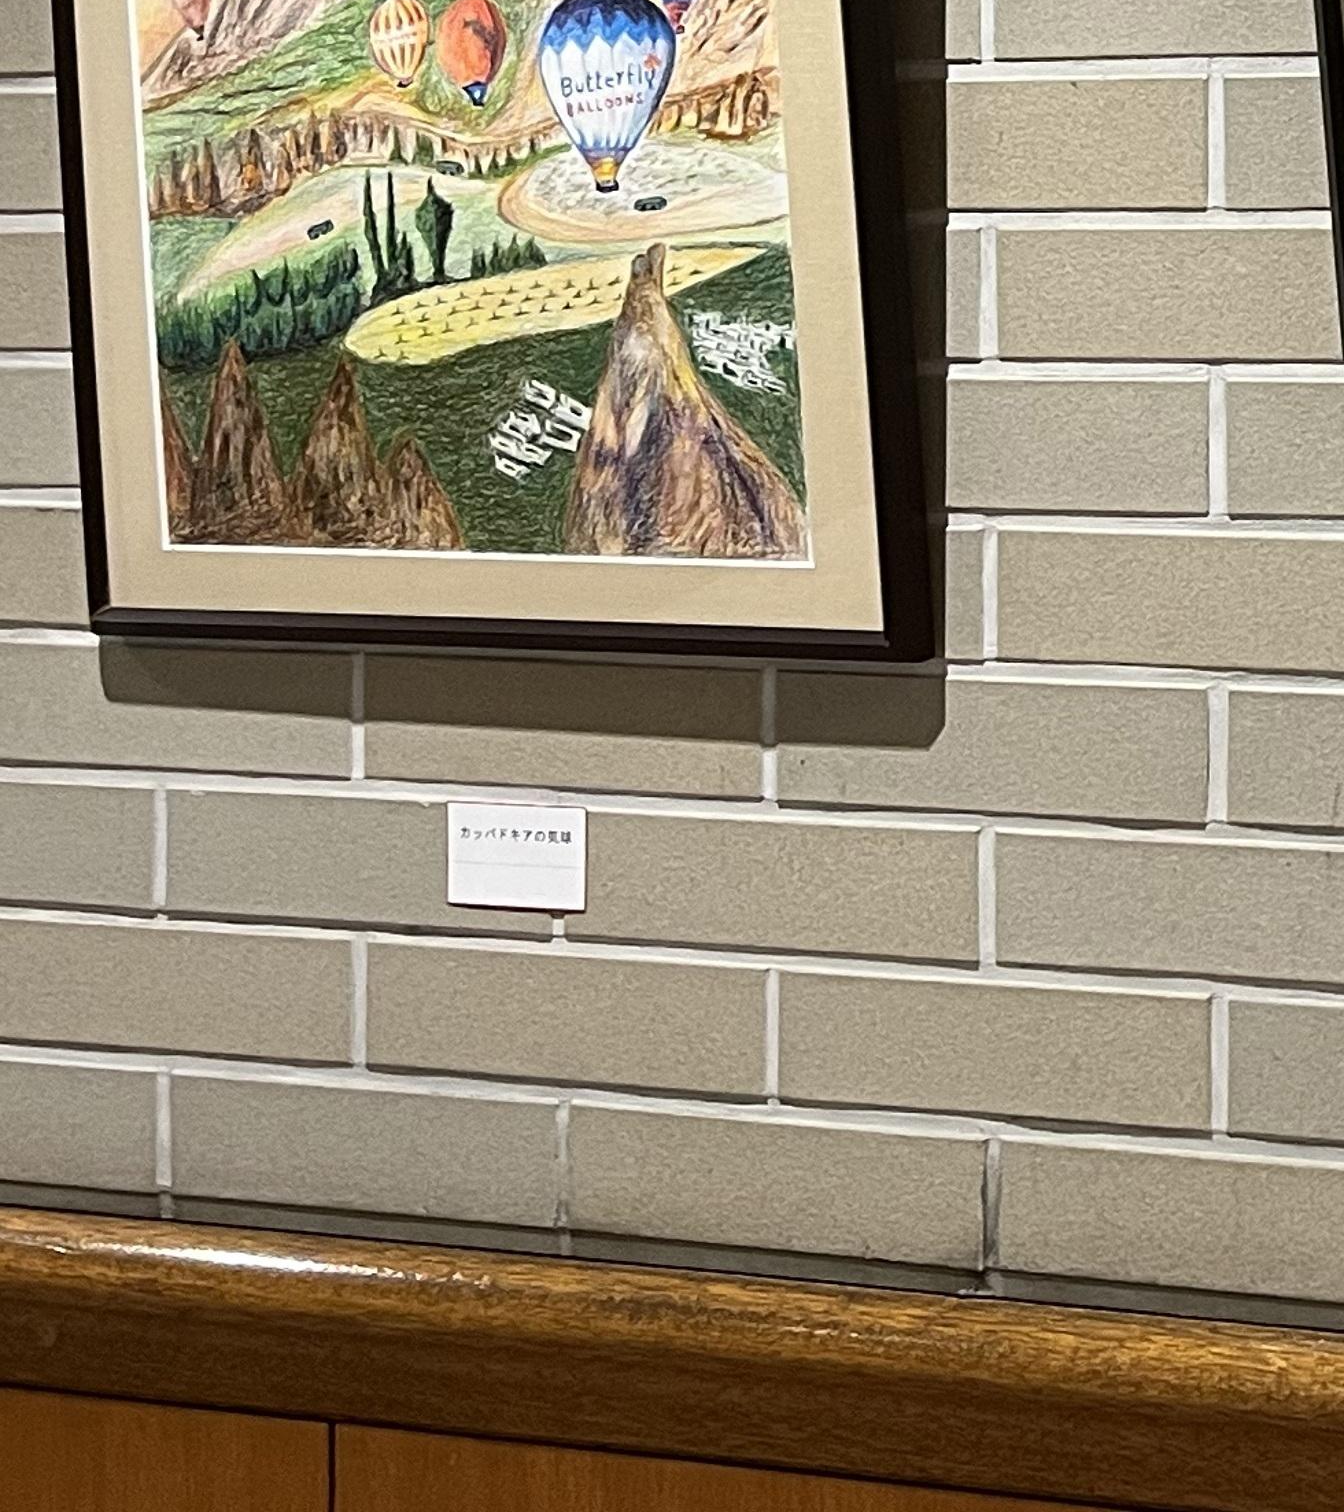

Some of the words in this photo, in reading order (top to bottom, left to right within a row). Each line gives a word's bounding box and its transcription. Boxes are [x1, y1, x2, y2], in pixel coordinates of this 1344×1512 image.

[560, 63, 656, 98] Butterfly
[566, 92, 644, 118] BALLOONS
[460, 826, 572, 844] カッパドキアの気球
